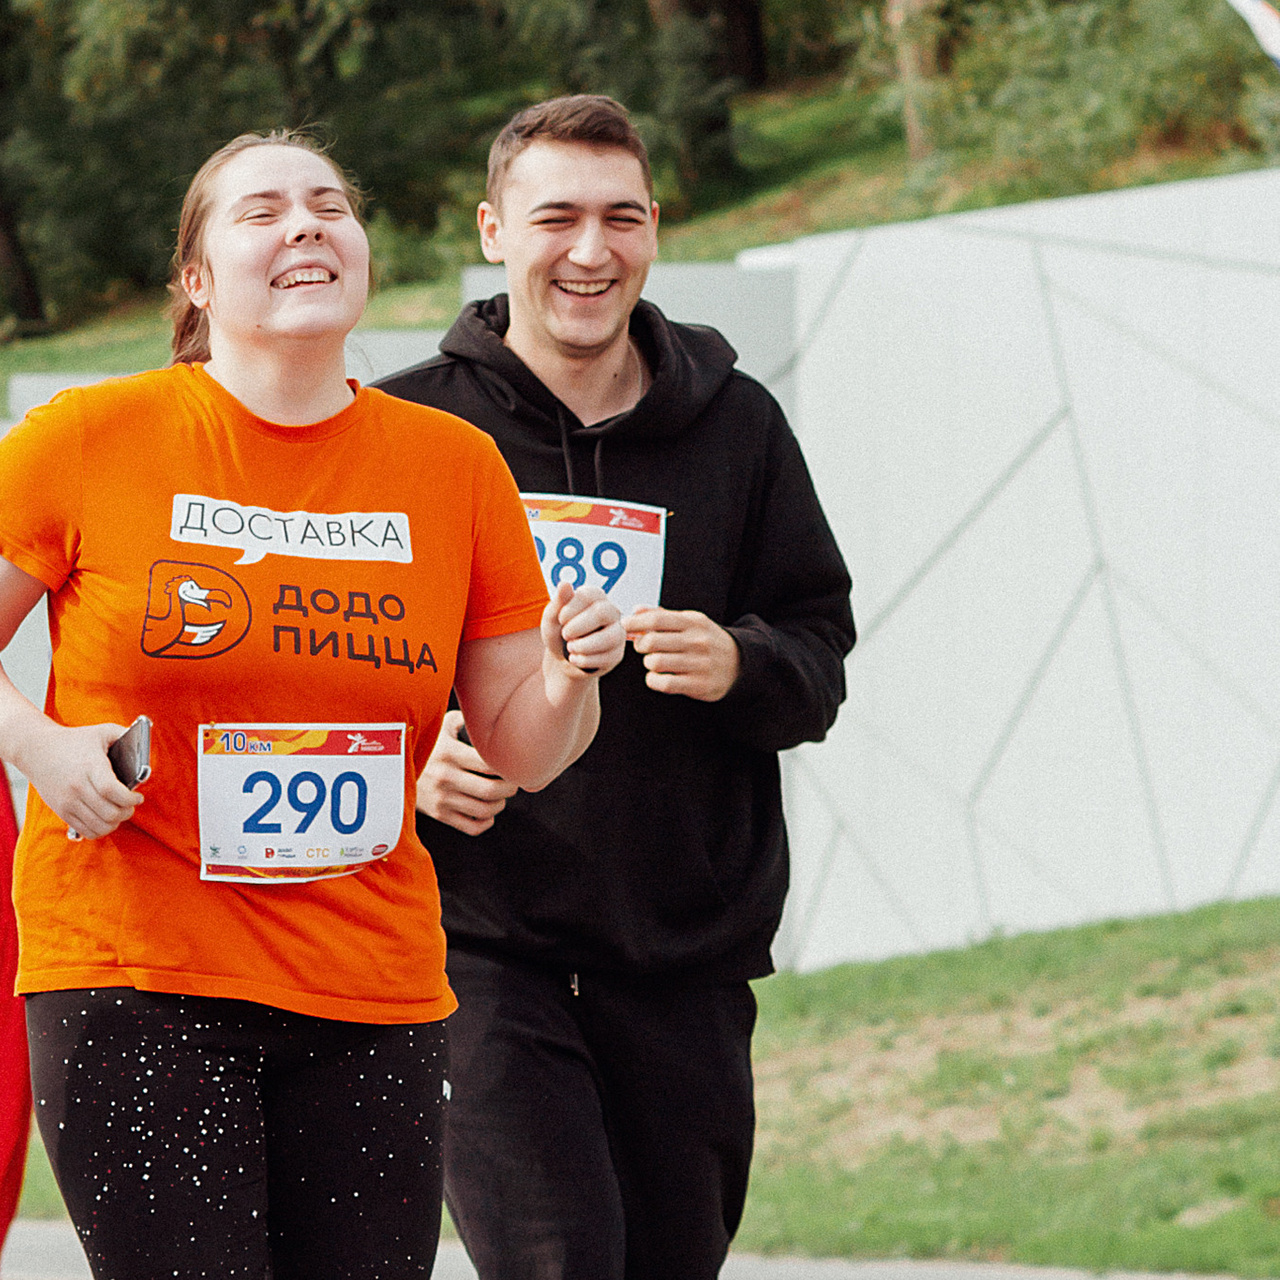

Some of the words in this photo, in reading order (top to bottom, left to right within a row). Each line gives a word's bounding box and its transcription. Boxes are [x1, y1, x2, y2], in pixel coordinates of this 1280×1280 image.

[179, 502, 404, 549] ДОСТАВКА
[534, 535, 628, 595] 89
[272, 584, 406, 624] ДОДО
[273, 625, 438, 673] ПИЦЦА
[242, 770, 368, 835] 290
